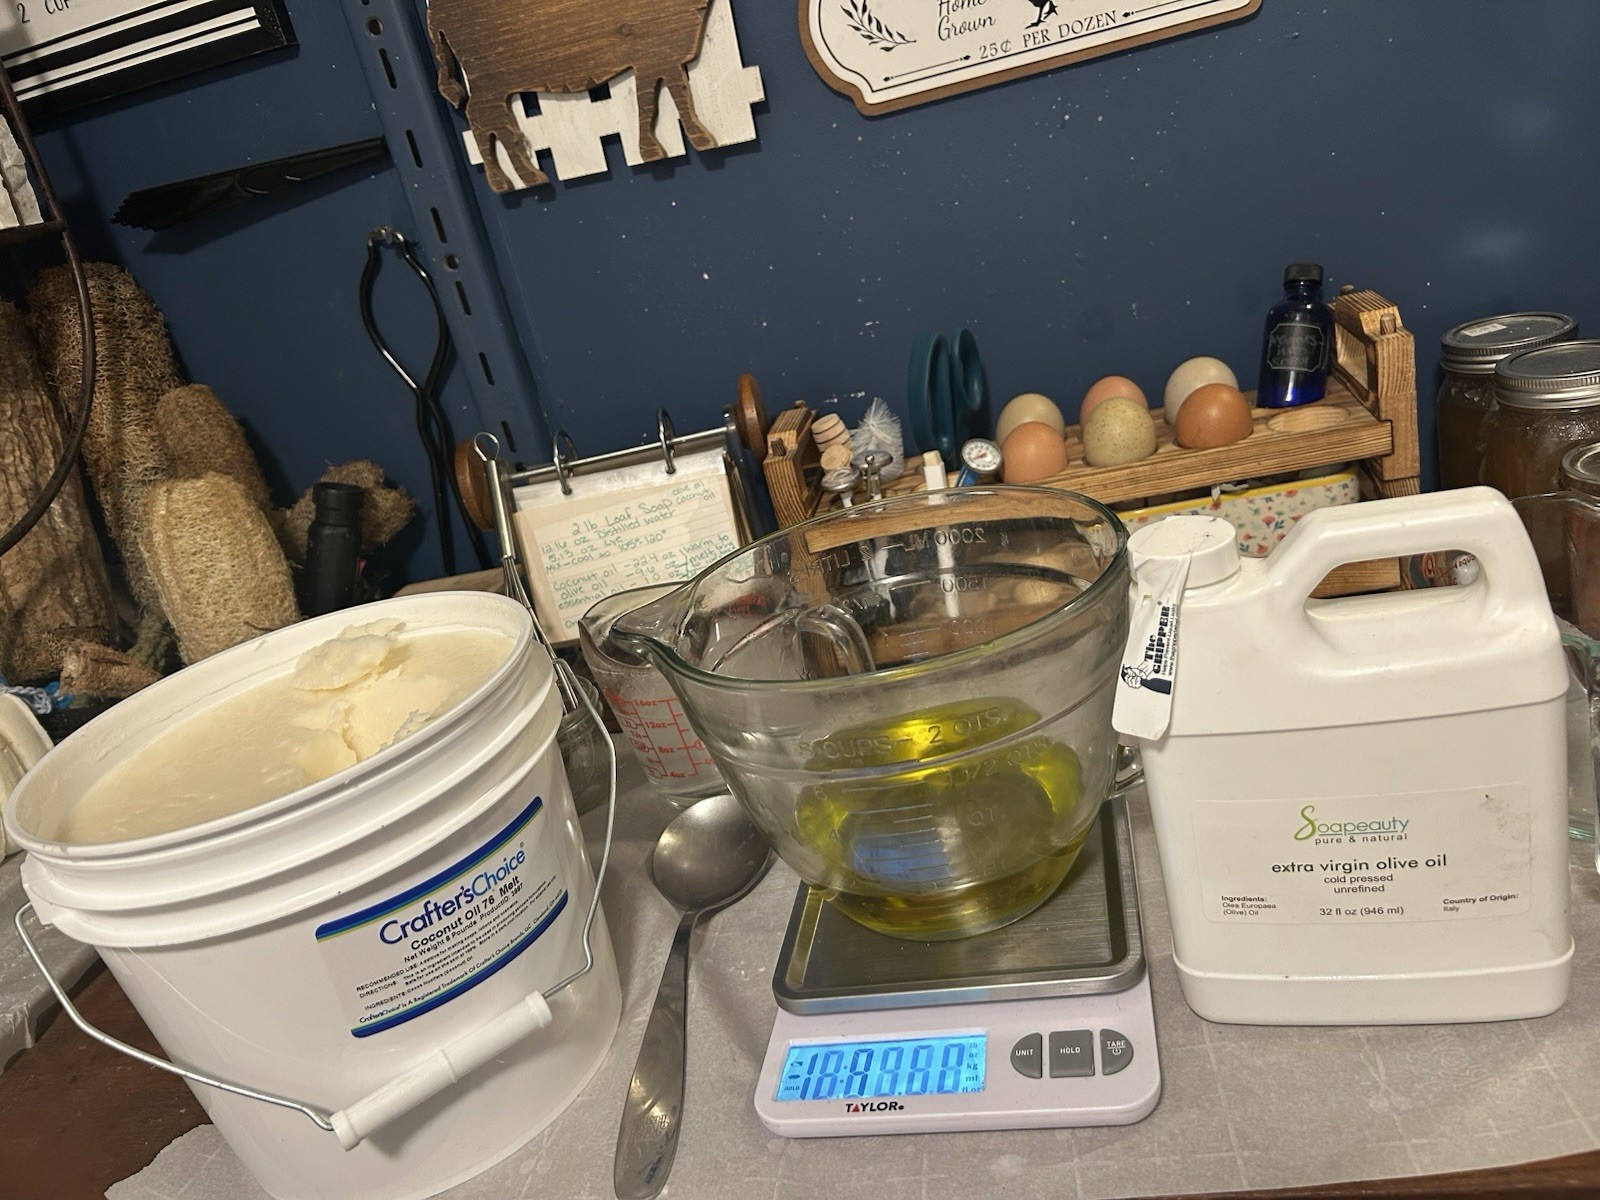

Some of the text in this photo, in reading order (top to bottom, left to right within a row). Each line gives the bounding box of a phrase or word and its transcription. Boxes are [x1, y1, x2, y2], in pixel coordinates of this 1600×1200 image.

[17, 3, 30, 23] 2
[937, 15, 996, 41] Grown
[979, 10, 1117, 60] 25¢ PER DOZEN
[573, 523, 580, 535] 2
[605, 507, 631, 526] Loaf
[639, 499, 672, 514] Soap
[574, 536, 590, 546] oz
[594, 518, 640, 538] Distilled
[717, 534, 729, 543] to
[581, 545, 598, 554] oz
[599, 550, 611, 558] to
[603, 563, 618, 577] oil
[662, 551, 676, 560] oz
[592, 579, 608, 591] oil
[665, 560, 679, 569] oz
[558, 590, 606, 609] essential
[1144, 634, 1157, 661] The
[1152, 605, 1170, 674] GRIPPER
[928, 724, 943, 744] 2
[1293, 805, 1409, 840] Soapeauty
[1315, 833, 1408, 845] pure & natural
[1271, 853, 1447, 874] extra virgin olive oil
[1324, 873, 1393, 885] cold pressed
[1333, 884, 1385, 894] unrefined
[1221, 895, 1268, 903] Ingredients:
[1489, 893, 1519, 901] Origin:
[411, 916, 463, 950] Coconut
[465, 904, 481, 921] Oil
[499, 876, 520, 897] Melt
[1319, 907, 1331, 916] 32
[1335, 907, 1341, 915] fl
[1360, 906, 1384, 916] (946
[1386, 906, 1404, 915] ml)
[404, 953, 417, 963] Net
[419, 939, 444, 955] Weight
[452, 920, 476, 938] Pounds
[356, 969, 404, 991] RECOMMENDED
[1060, 1046, 1081, 1054] HOLD
[966, 1062, 979, 1071] kg
[965, 1074, 979, 1082] ml
